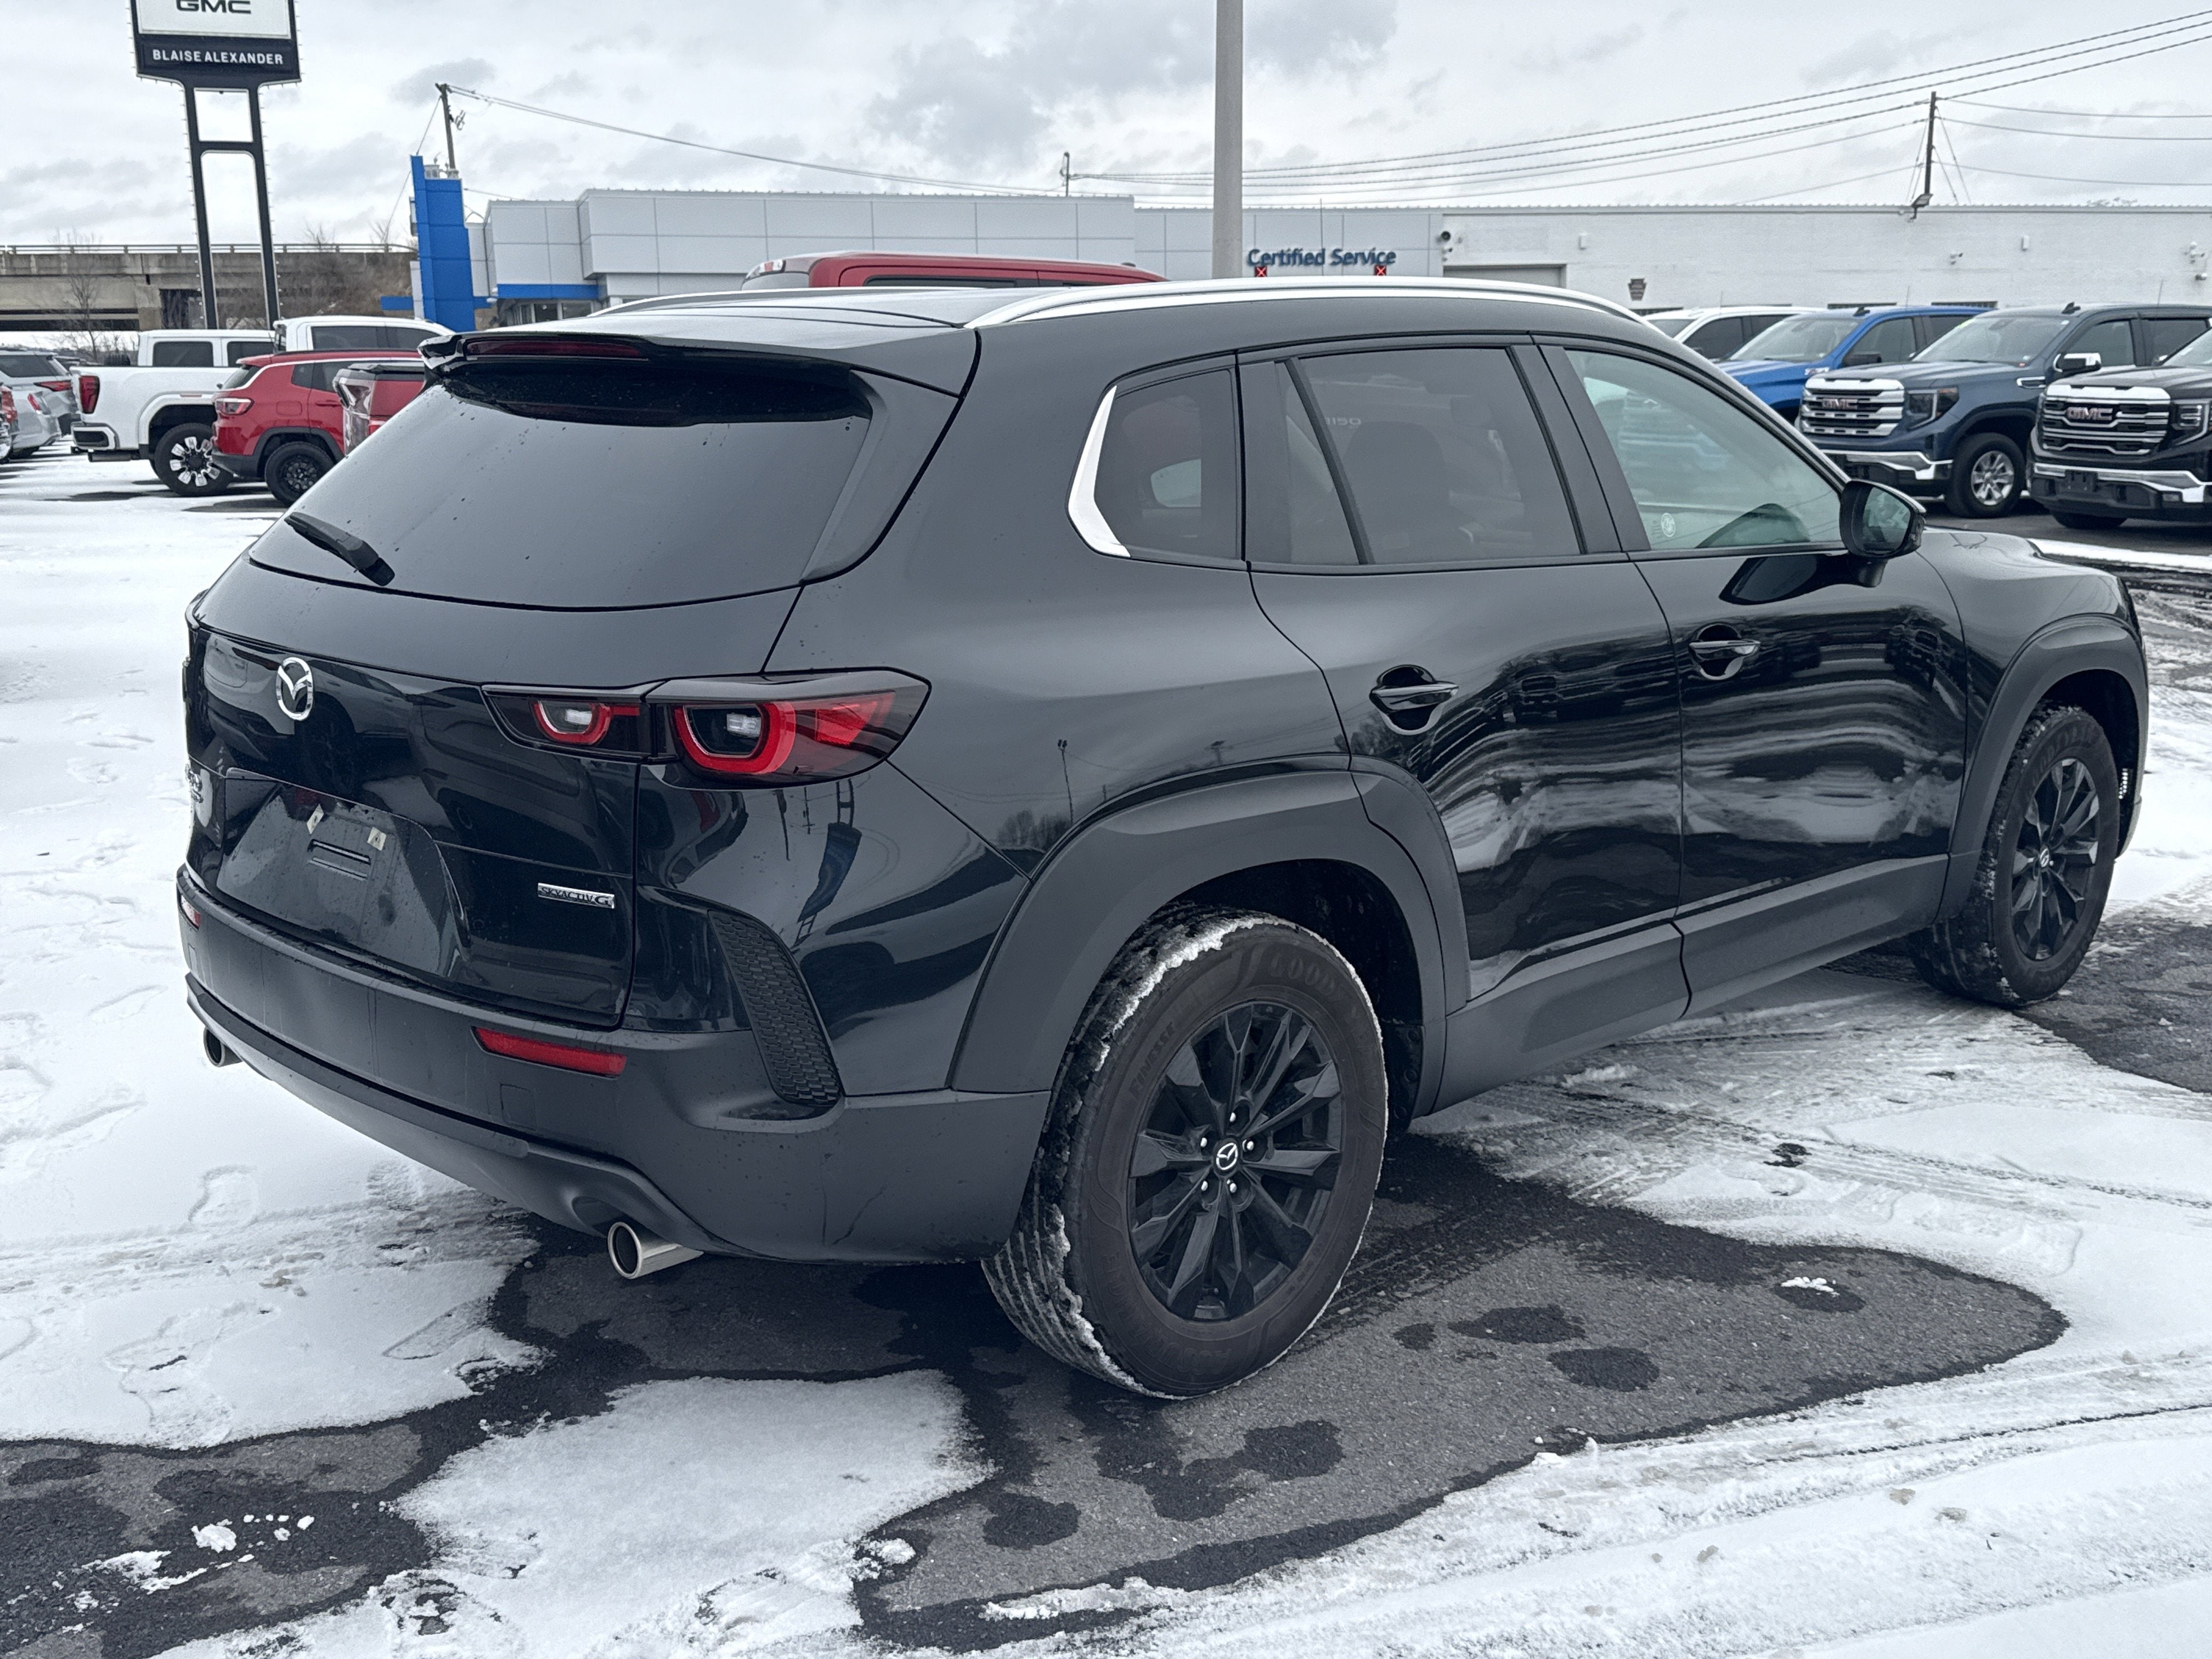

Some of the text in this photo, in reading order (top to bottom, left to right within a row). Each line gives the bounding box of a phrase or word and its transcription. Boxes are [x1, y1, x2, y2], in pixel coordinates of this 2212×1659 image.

[176, 0, 251, 14] GMC
[153, 49, 284, 65] BLAISE ALEXANDER
[1248, 247, 1396, 266] Certified Service
[2067, 407, 2113, 421] GMC
